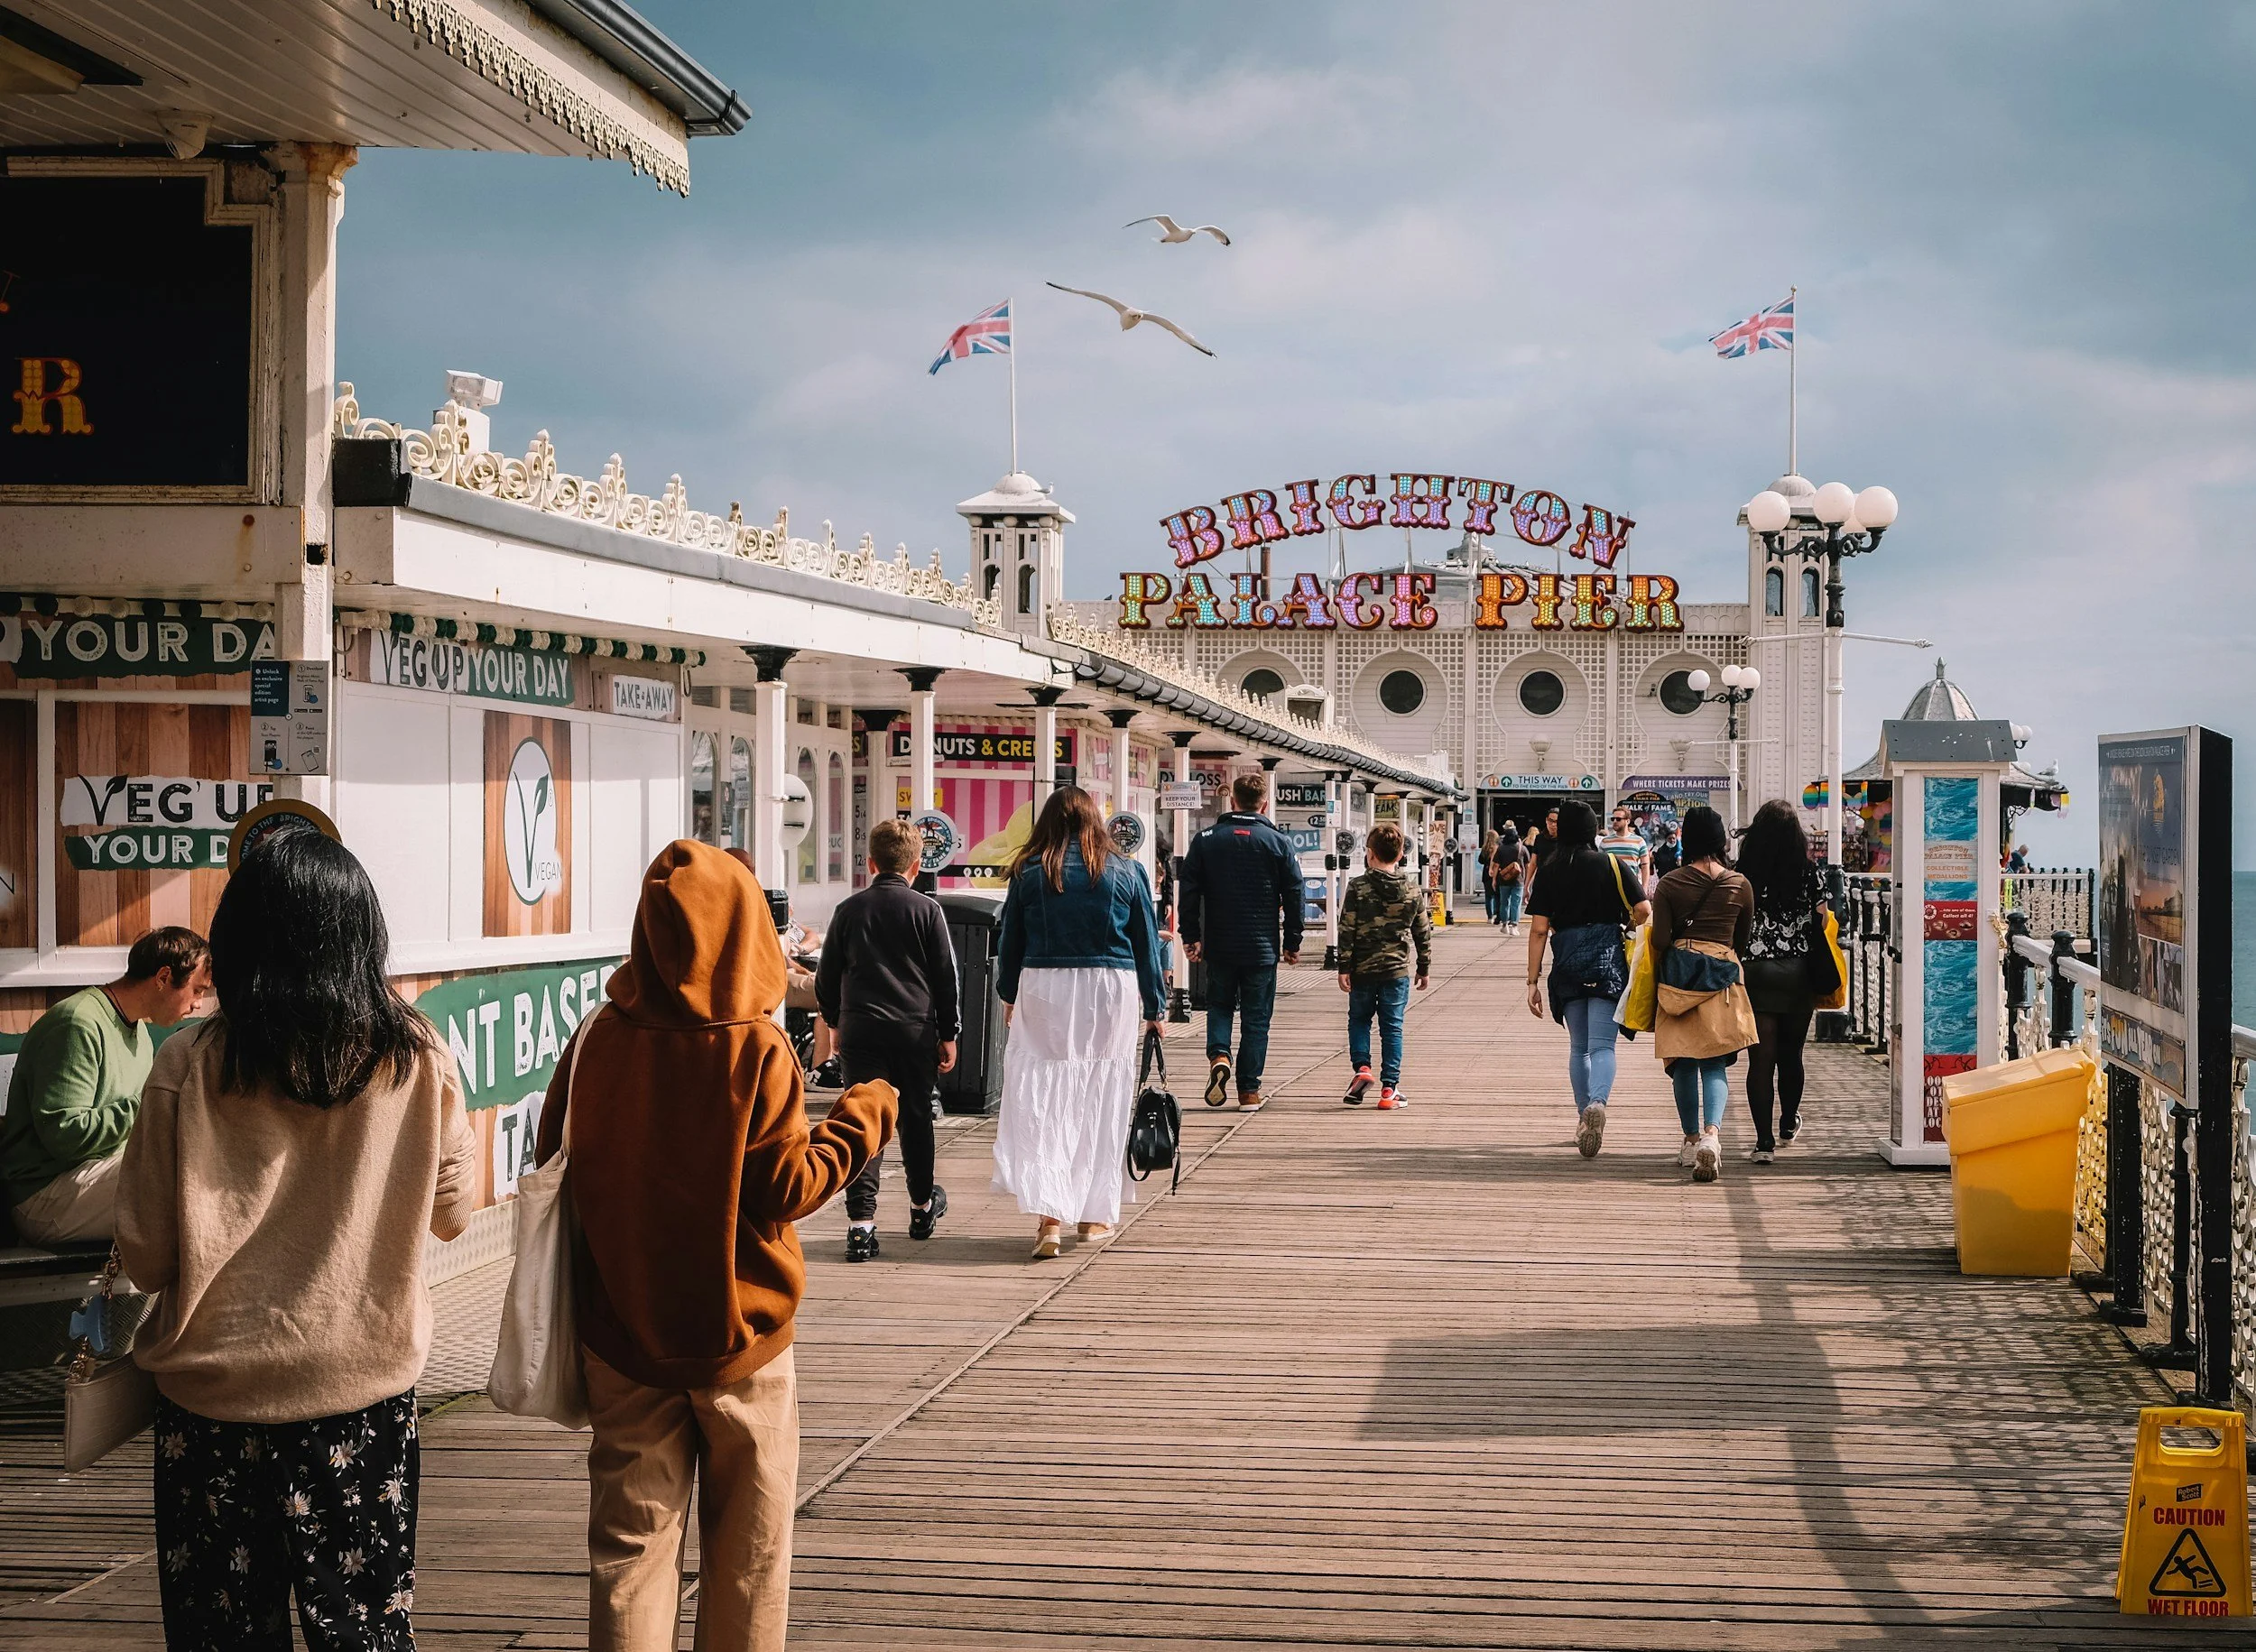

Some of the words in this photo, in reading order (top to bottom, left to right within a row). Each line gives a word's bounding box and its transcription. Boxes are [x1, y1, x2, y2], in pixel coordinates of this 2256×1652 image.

[1160, 473, 1636, 568] BRIGHTON
[1118, 572, 1438, 630] PALACE
[1477, 573, 1685, 631] PIER
[27, 620, 189, 662] YOUR
[212, 623, 275, 662] DA
[431, 643, 464, 691] UP
[471, 648, 527, 696] YOUR
[533, 655, 569, 699] DAY
[899, 736, 975, 755] DNUTS
[981, 739, 994, 756] &
[997, 740, 1063, 758] CRES
[1518, 776, 1539, 784] THIS
[1541, 776, 1563, 784] WAY
[1632, 780, 1656, 788] WHERE
[1659, 780, 1685, 788] TICKETS
[1687, 780, 1706, 788] MAKE
[1305, 789, 1326, 801] BAR
[279, 815, 316, 833] BRIGHTO
[84, 835, 193, 863] YOUR
[535, 862, 562, 881] VEGAN
[1928, 1107, 1939, 1117] AT
[2177, 1485, 2200, 1497] Robert
[2181, 1490, 2200, 1501] Scott
[2153, 1507, 2225, 1527] CAUTION
[2148, 1599, 2180, 1616] WET
[2184, 1600, 2229, 1617] FLOOR
